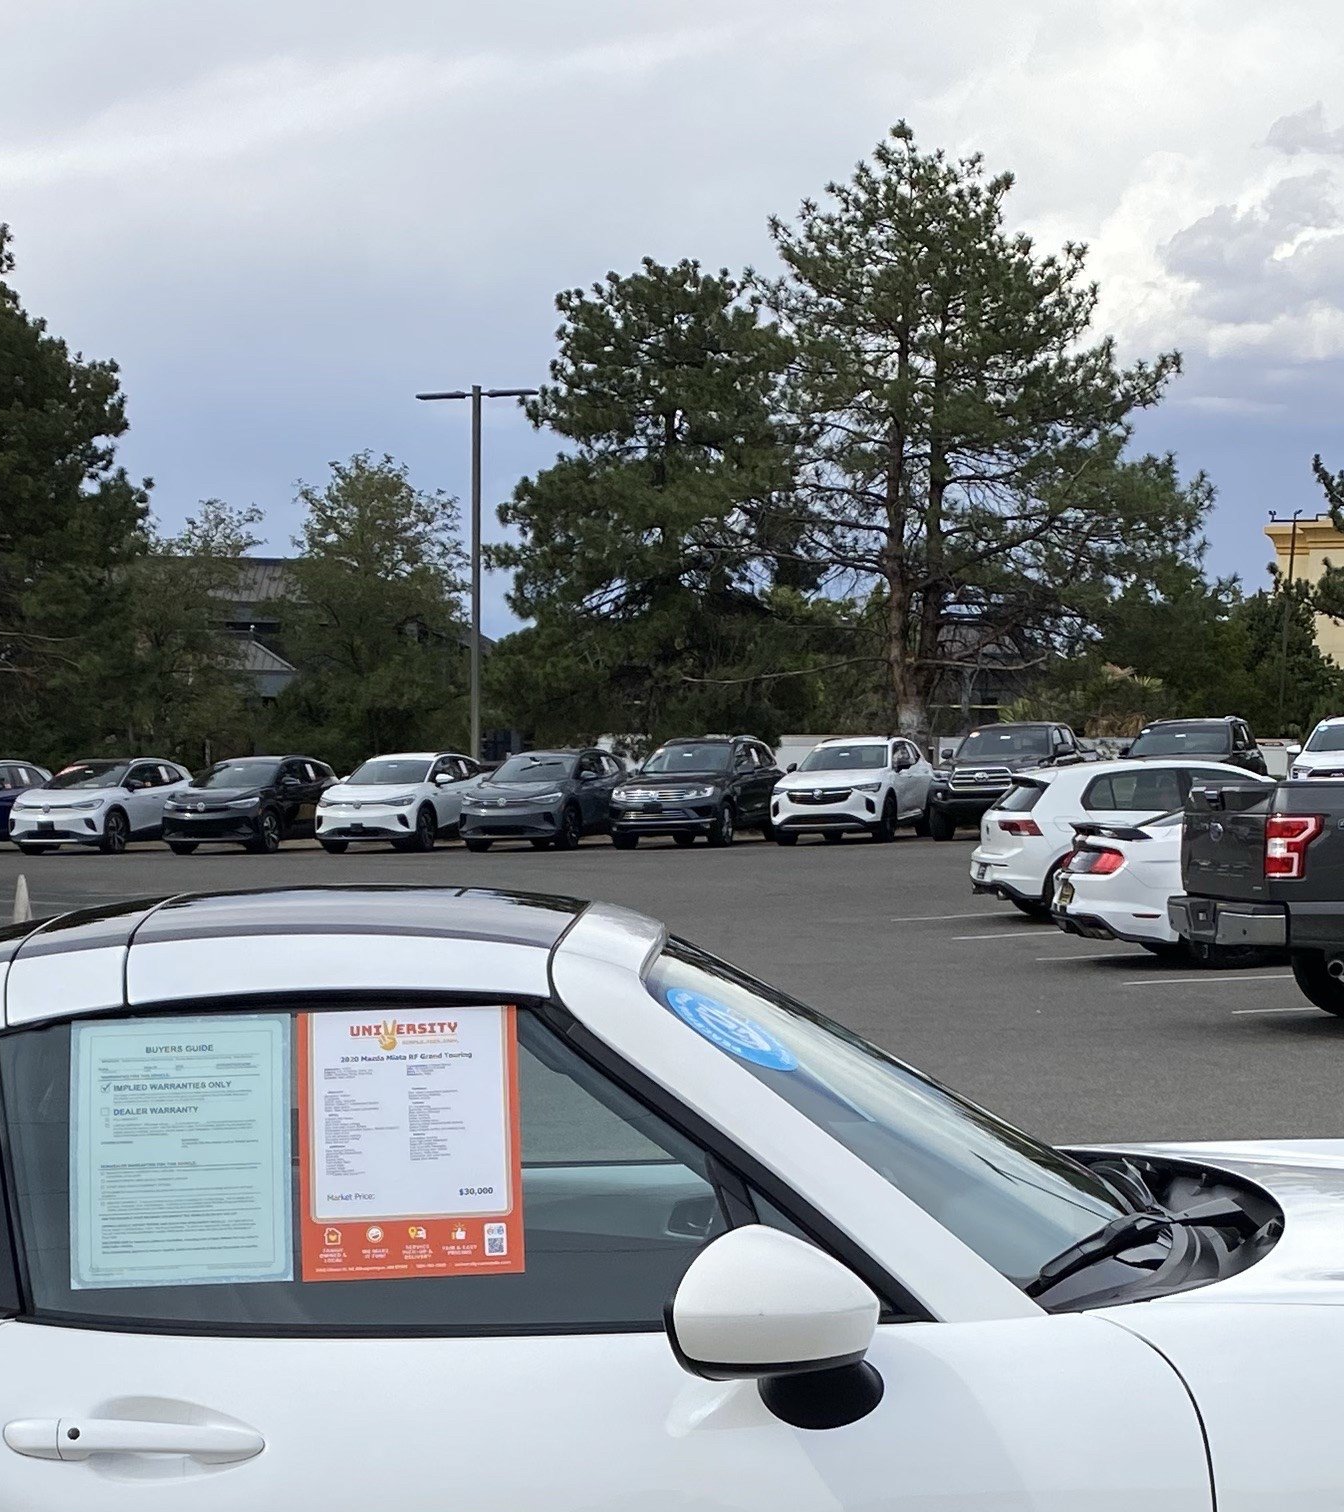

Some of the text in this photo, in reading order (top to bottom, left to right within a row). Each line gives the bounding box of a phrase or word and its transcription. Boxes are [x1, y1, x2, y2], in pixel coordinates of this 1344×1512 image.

[349, 1020, 458, 1037] UNIVERSITY
[145, 1044, 214, 1054] BUYERS GUIDE
[420, 1052, 442, 1060] Grand
[444, 1051, 472, 1059] Touring
[113, 1081, 232, 1092] IMPLIED WARRANTIES ONLY
[113, 1106, 199, 1116] DEALER WARRANTY
[459, 1187, 494, 1196] $30,000
[327, 1192, 375, 1202] Market Price:
